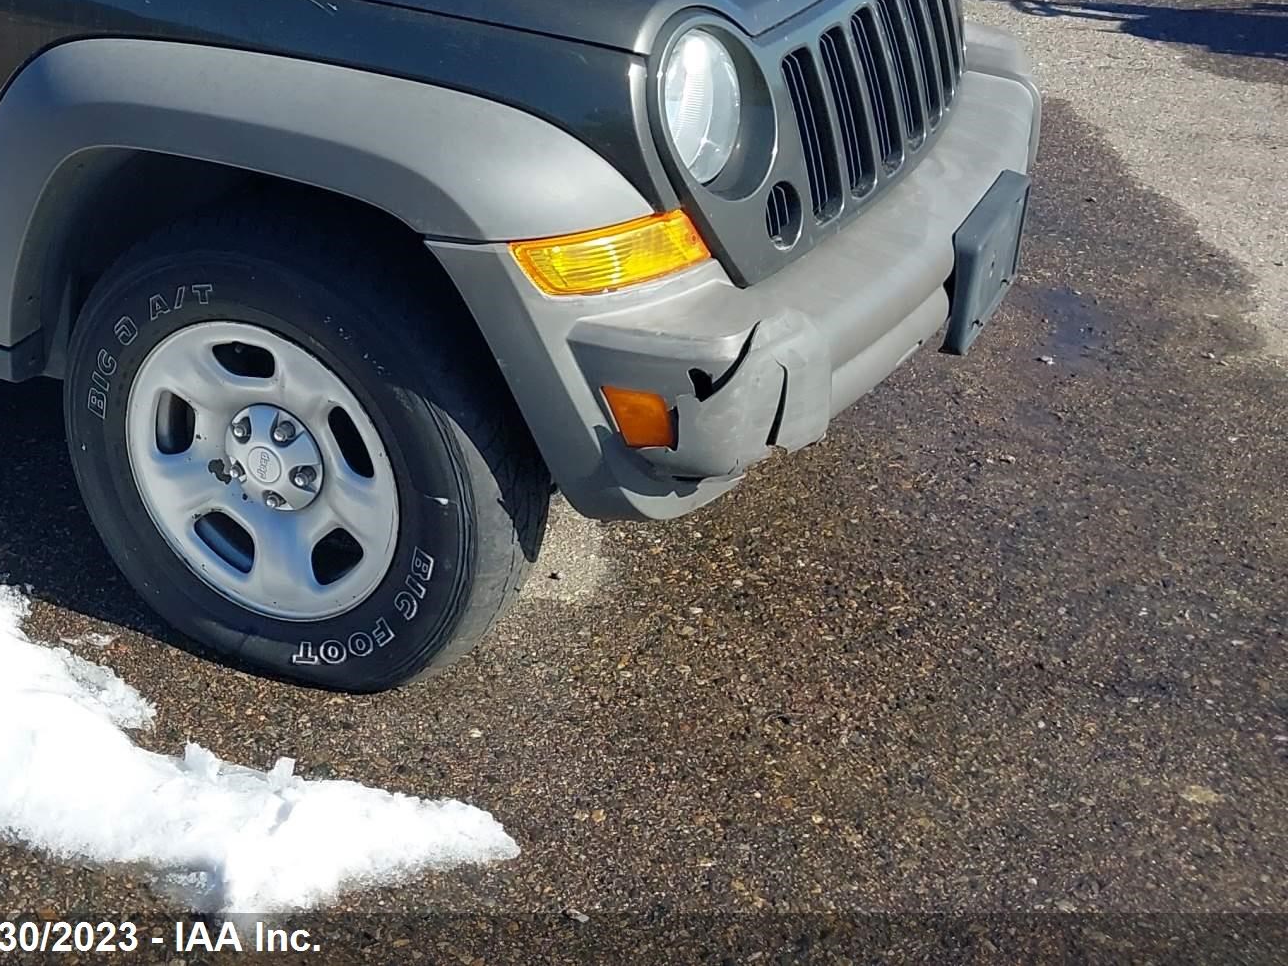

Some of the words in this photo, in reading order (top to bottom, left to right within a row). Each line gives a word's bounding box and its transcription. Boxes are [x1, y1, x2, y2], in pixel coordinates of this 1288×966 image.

[87, 348, 117, 420] BIG
[149, 284, 213, 321] A/T
[394, 546, 434, 621] BIG
[292, 616, 396, 665] FOOT
